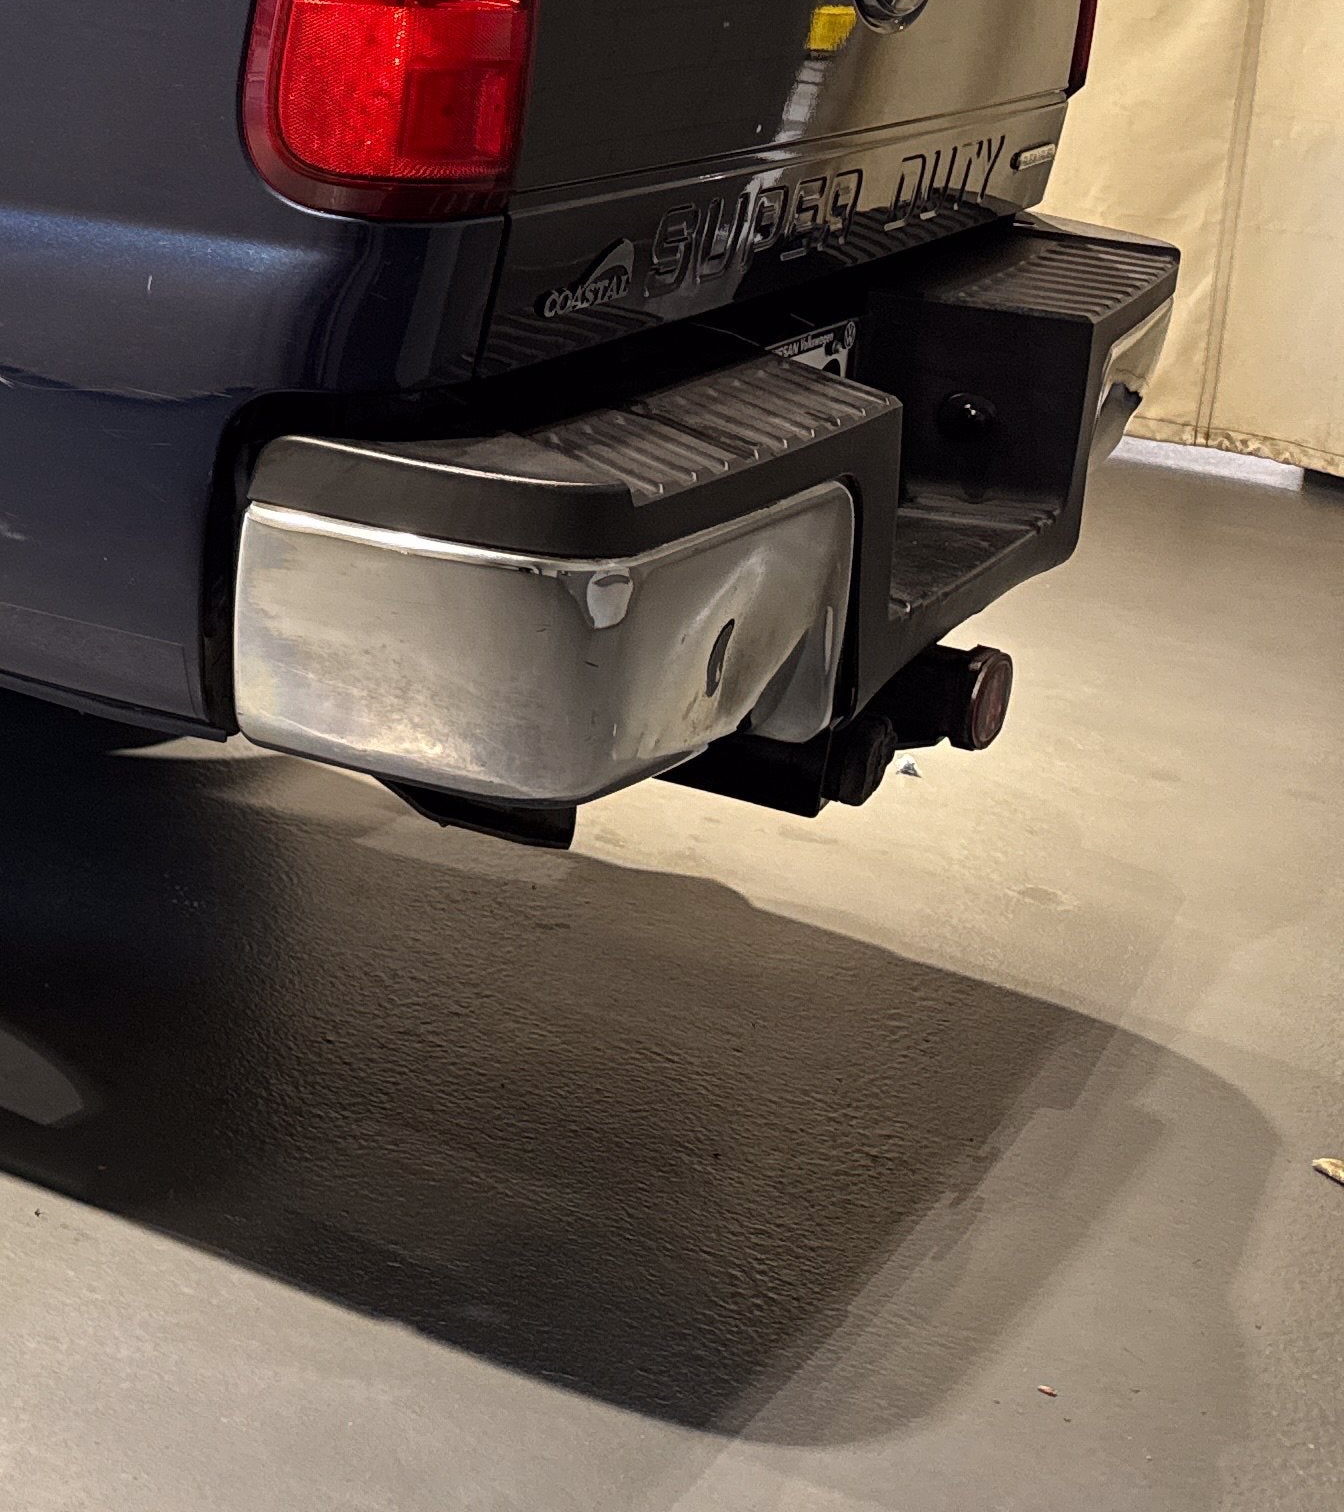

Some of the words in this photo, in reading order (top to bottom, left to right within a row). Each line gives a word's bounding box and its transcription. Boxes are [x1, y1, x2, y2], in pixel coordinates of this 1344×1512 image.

[644, 168, 864, 298] SUPER
[883, 134, 1006, 232] DUTY
[542, 274, 631, 319] COASTAL
